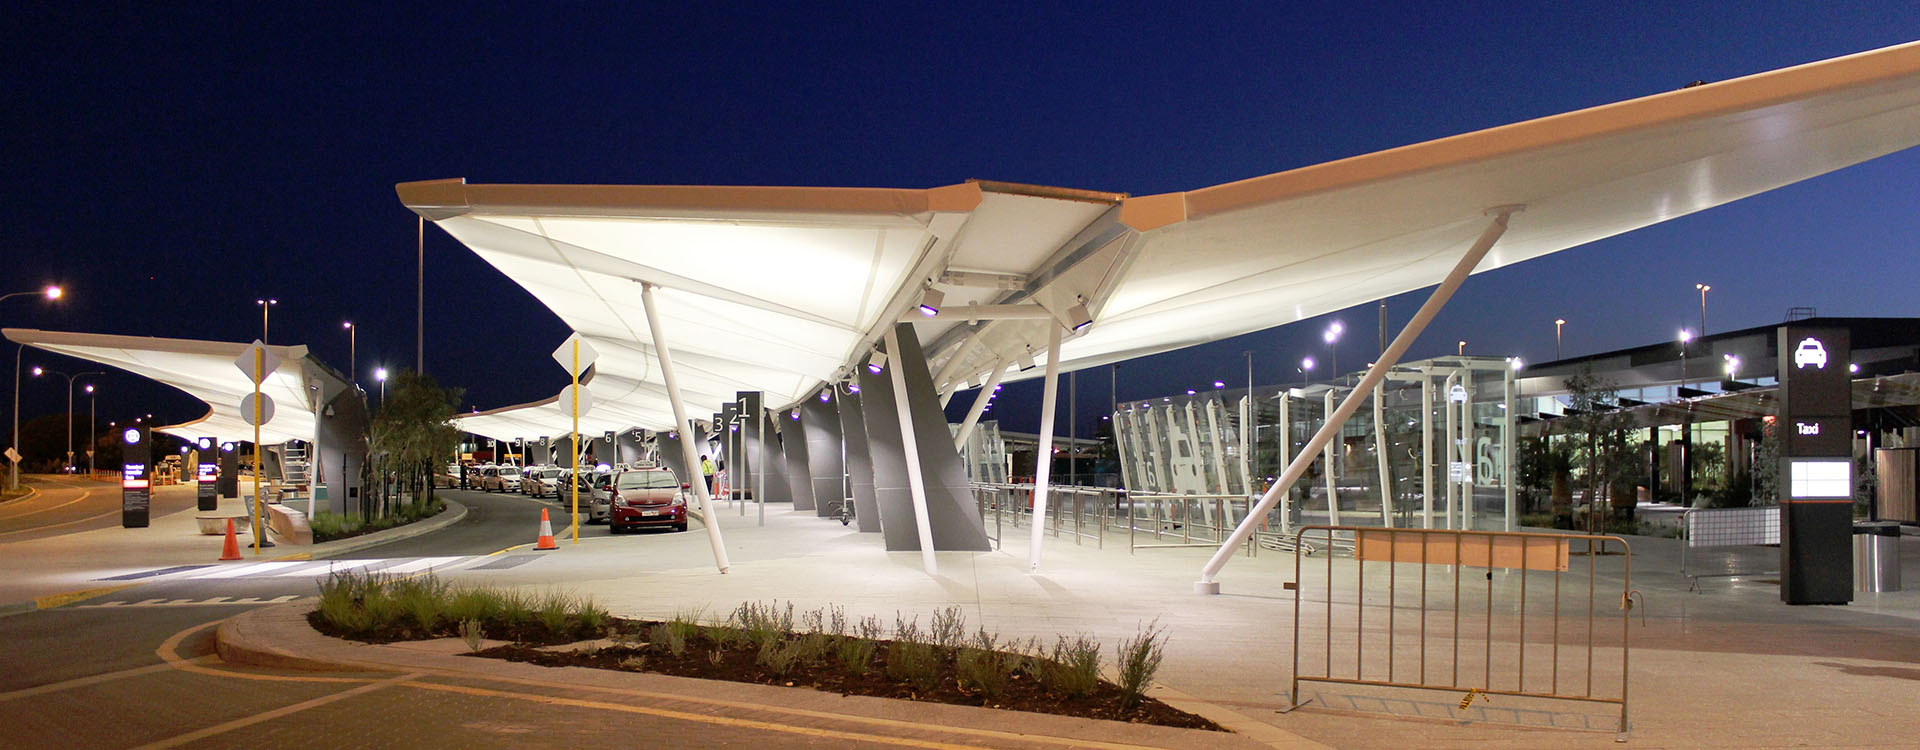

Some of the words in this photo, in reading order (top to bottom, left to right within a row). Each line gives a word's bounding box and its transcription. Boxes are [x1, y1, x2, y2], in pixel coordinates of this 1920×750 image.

[738, 397, 750, 418] 1
[729, 407, 740, 424] 2
[714, 417, 723, 432] 3
[1796, 422, 1819, 435] Taxi
[539, 438, 545, 446] 8
[605, 433, 612, 443] 6
[635, 431, 642, 442] 5
[487, 440, 495, 448] 10
[515, 439, 521, 447] 9
